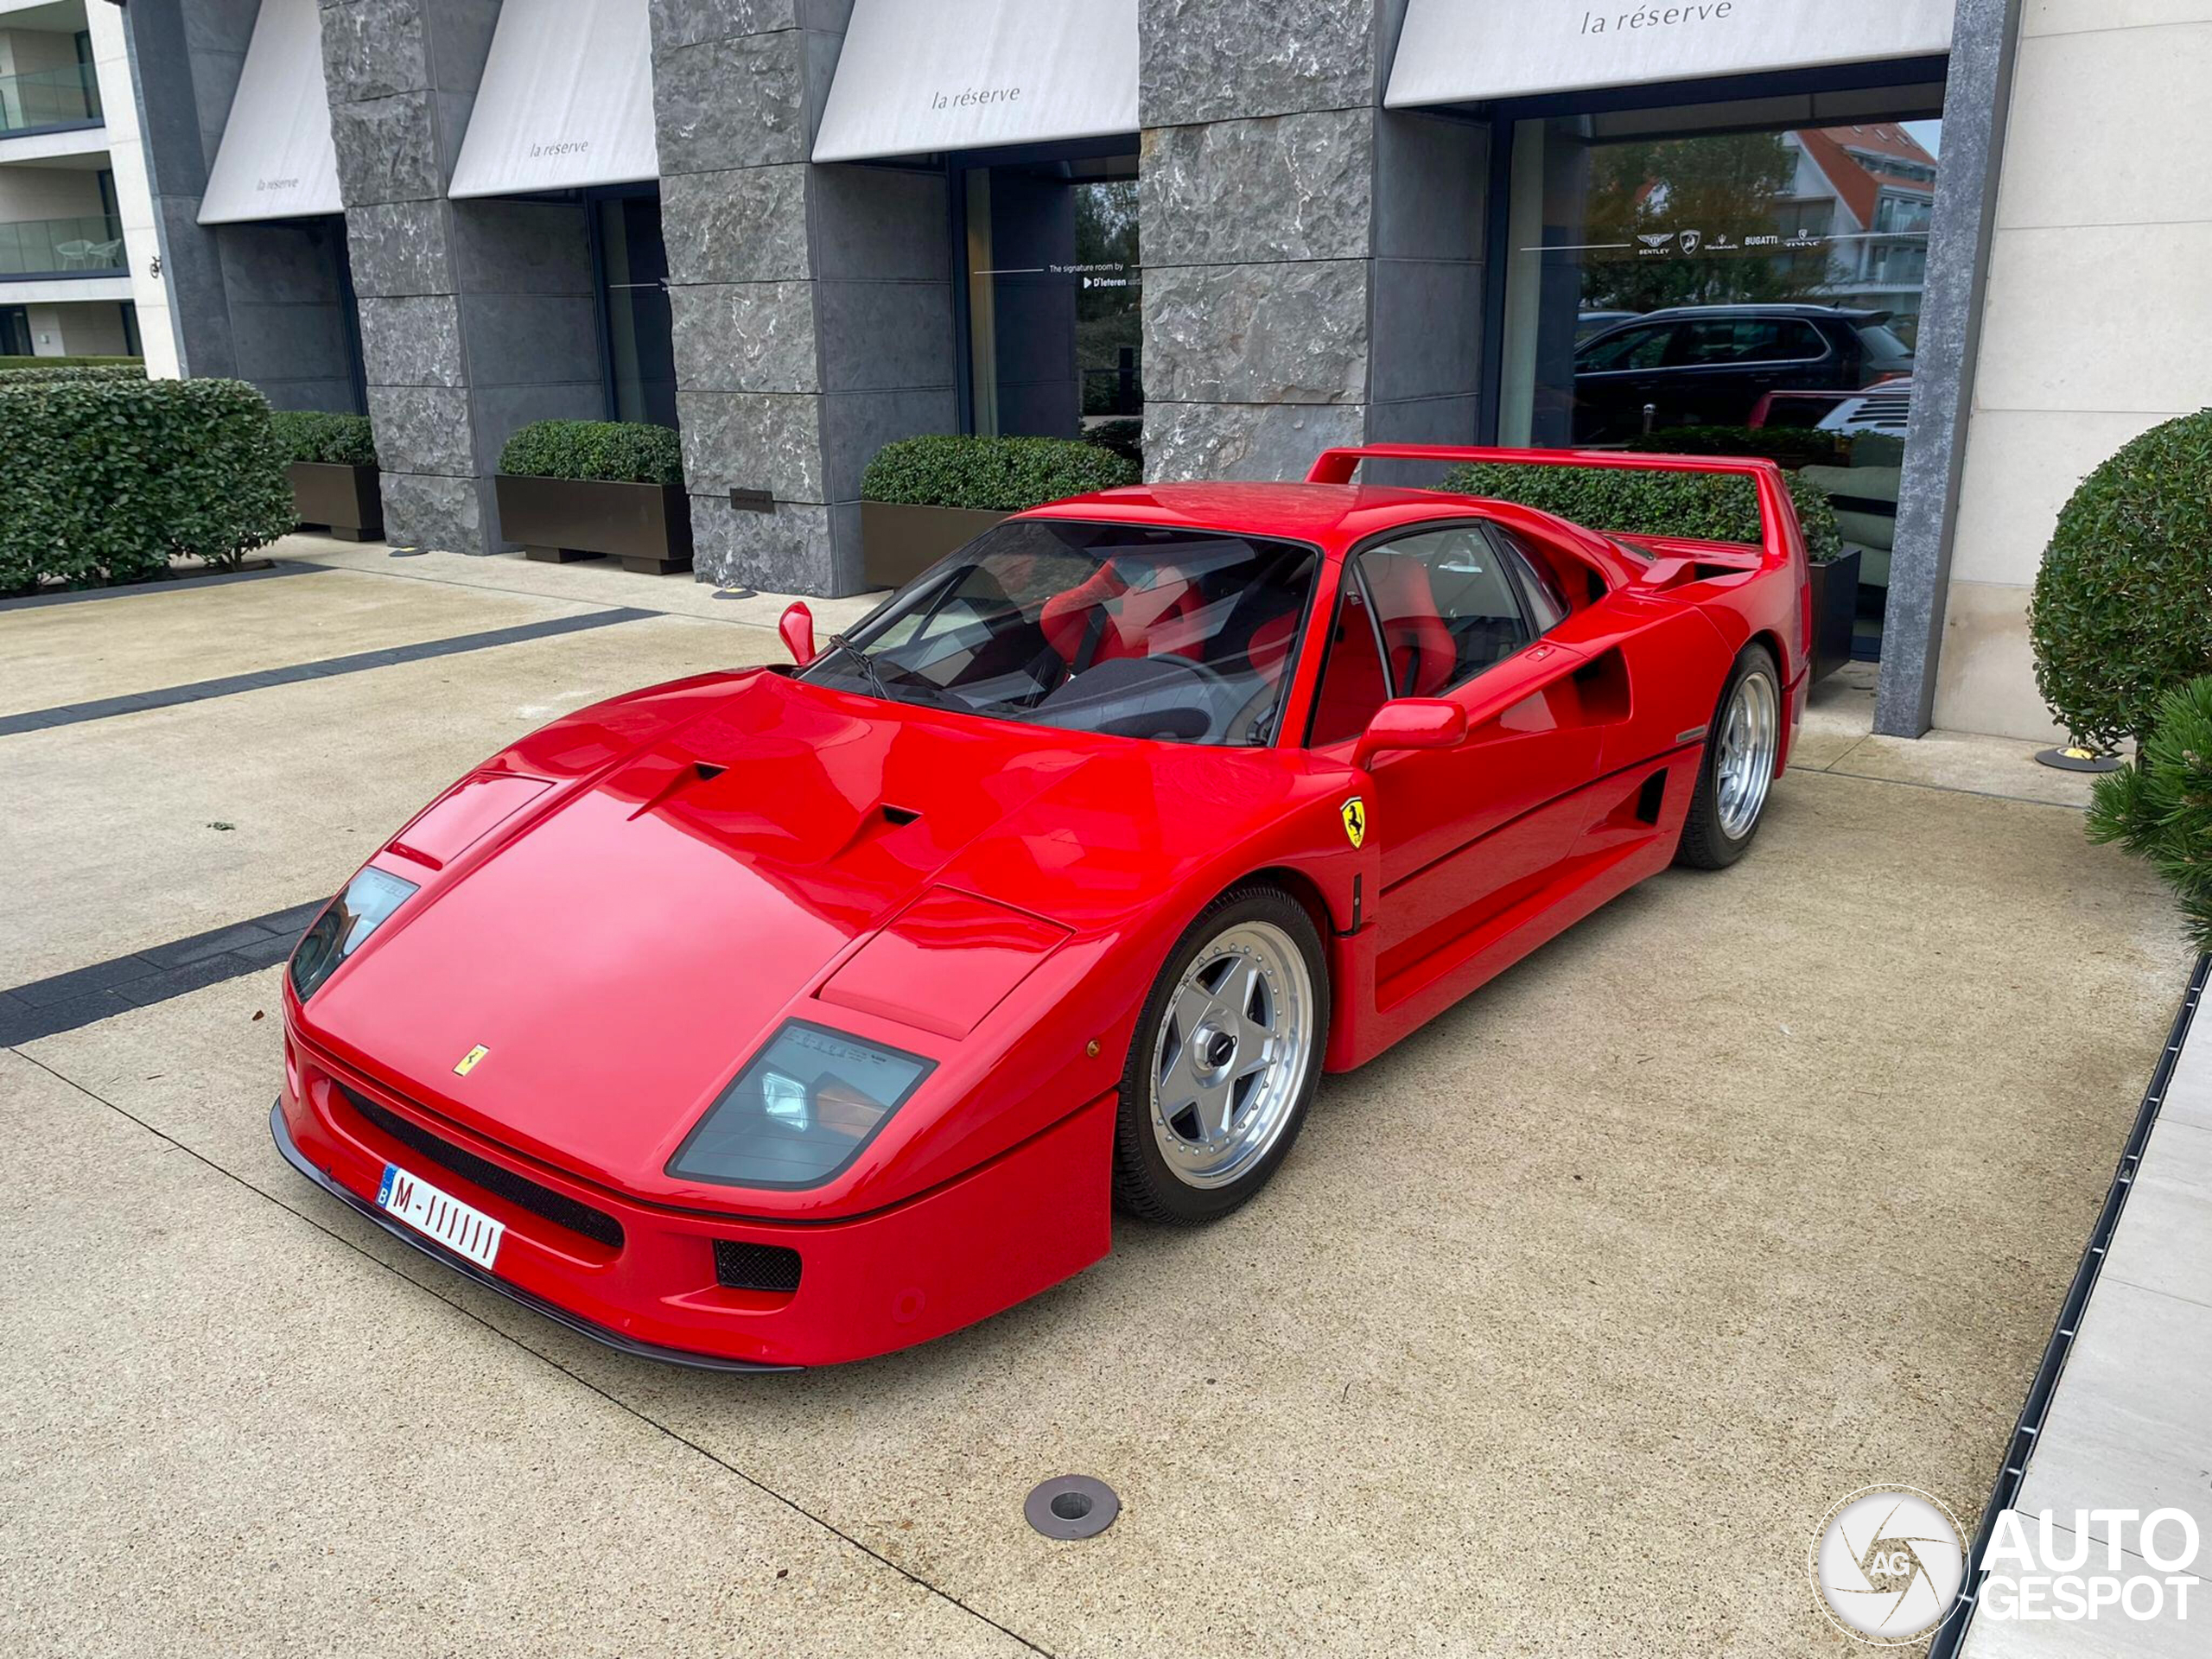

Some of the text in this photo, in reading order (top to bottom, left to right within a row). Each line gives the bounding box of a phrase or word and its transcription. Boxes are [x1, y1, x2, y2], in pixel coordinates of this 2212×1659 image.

[1581, 2, 1732, 35] la réserve
[931, 87, 1020, 110] la réserve
[530, 143, 541, 157] la
[1745, 235, 1778, 246] BUGATTI
[1049, 262, 1123, 274] The signature room by
[378, 1187, 389, 1205] B
